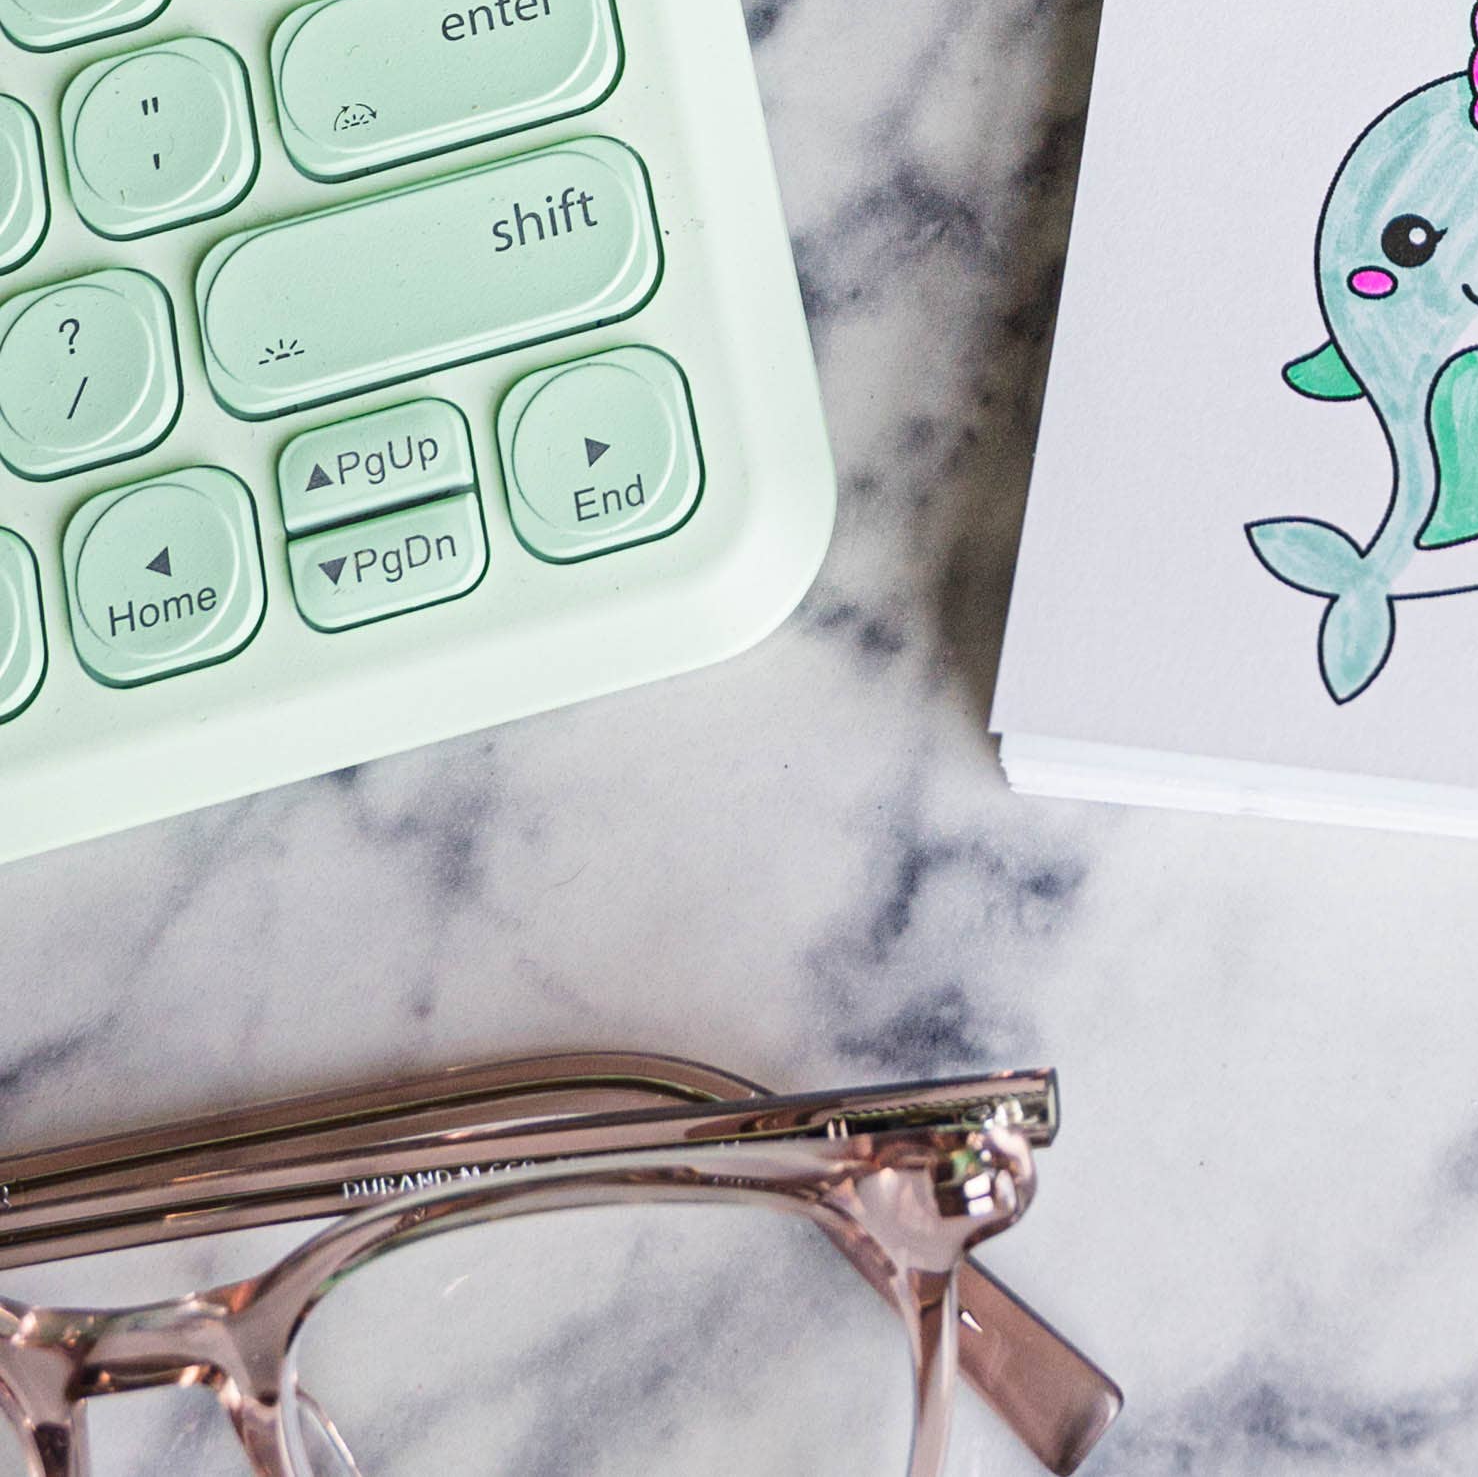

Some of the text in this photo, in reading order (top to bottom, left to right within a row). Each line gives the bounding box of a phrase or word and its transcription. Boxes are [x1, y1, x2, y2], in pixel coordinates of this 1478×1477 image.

[492, 187, 598, 252] shift
[337, 433, 440, 486] PgUp
[573, 473, 645, 522] End
[353, 534, 458, 585] PgDn
[108, 587, 217, 637] Home
[342, 1169, 452, 1199] DURAND
